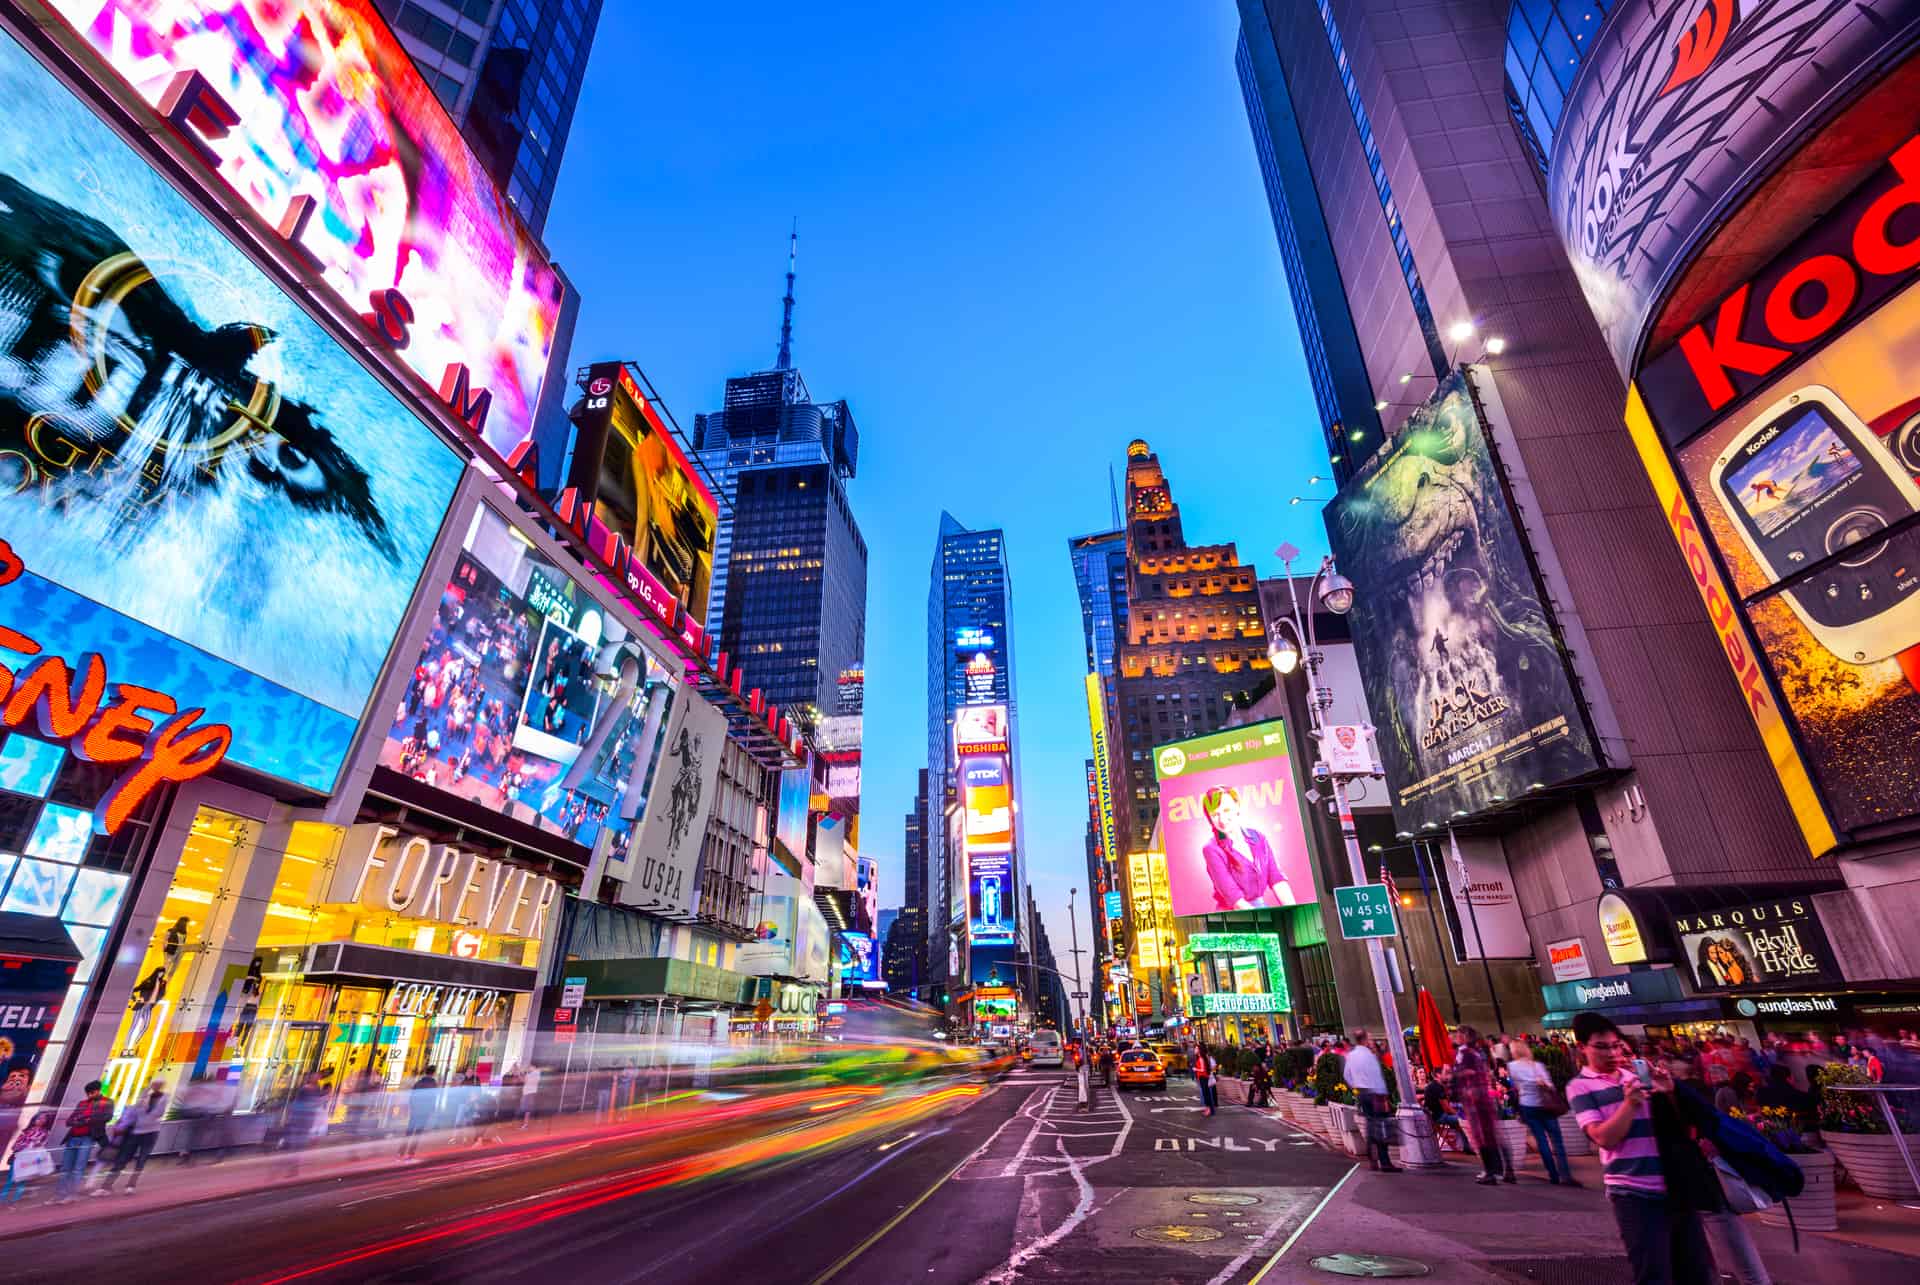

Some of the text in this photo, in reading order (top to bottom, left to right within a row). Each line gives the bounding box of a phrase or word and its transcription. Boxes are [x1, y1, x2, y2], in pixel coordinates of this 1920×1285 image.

[588, 397, 607, 408] LG
[1745, 425, 1780, 456] Kodak
[1670, 491, 1769, 719] Kodak
[1428, 679, 1489, 729] JACK
[1422, 714, 1461, 750] GIANT
[1460, 697, 1510, 730] SLAYER
[958, 743, 1008, 753] TOSHIBA
[1448, 735, 1493, 765] MARCH 1
[976, 769, 1000, 779] TDK
[1095, 729, 1115, 857] VISIONWALK.ORG
[351, 826, 557, 939] FOREVER
[642, 856, 682, 901] USPA
[1342, 903, 1389, 917] W 45 St
[1354, 892, 1369, 902] To
[1676, 901, 1804, 932] MARQUIS
[1745, 925, 1800, 957] Jekyll
[1760, 950, 1817, 976] Hyde
[390, 982, 500, 1017] FOREVER 21
[1614, 981, 1631, 995] hut
[1757, 997, 1837, 1015] sunglass hut
[1154, 1136, 1281, 1152] ONLY
